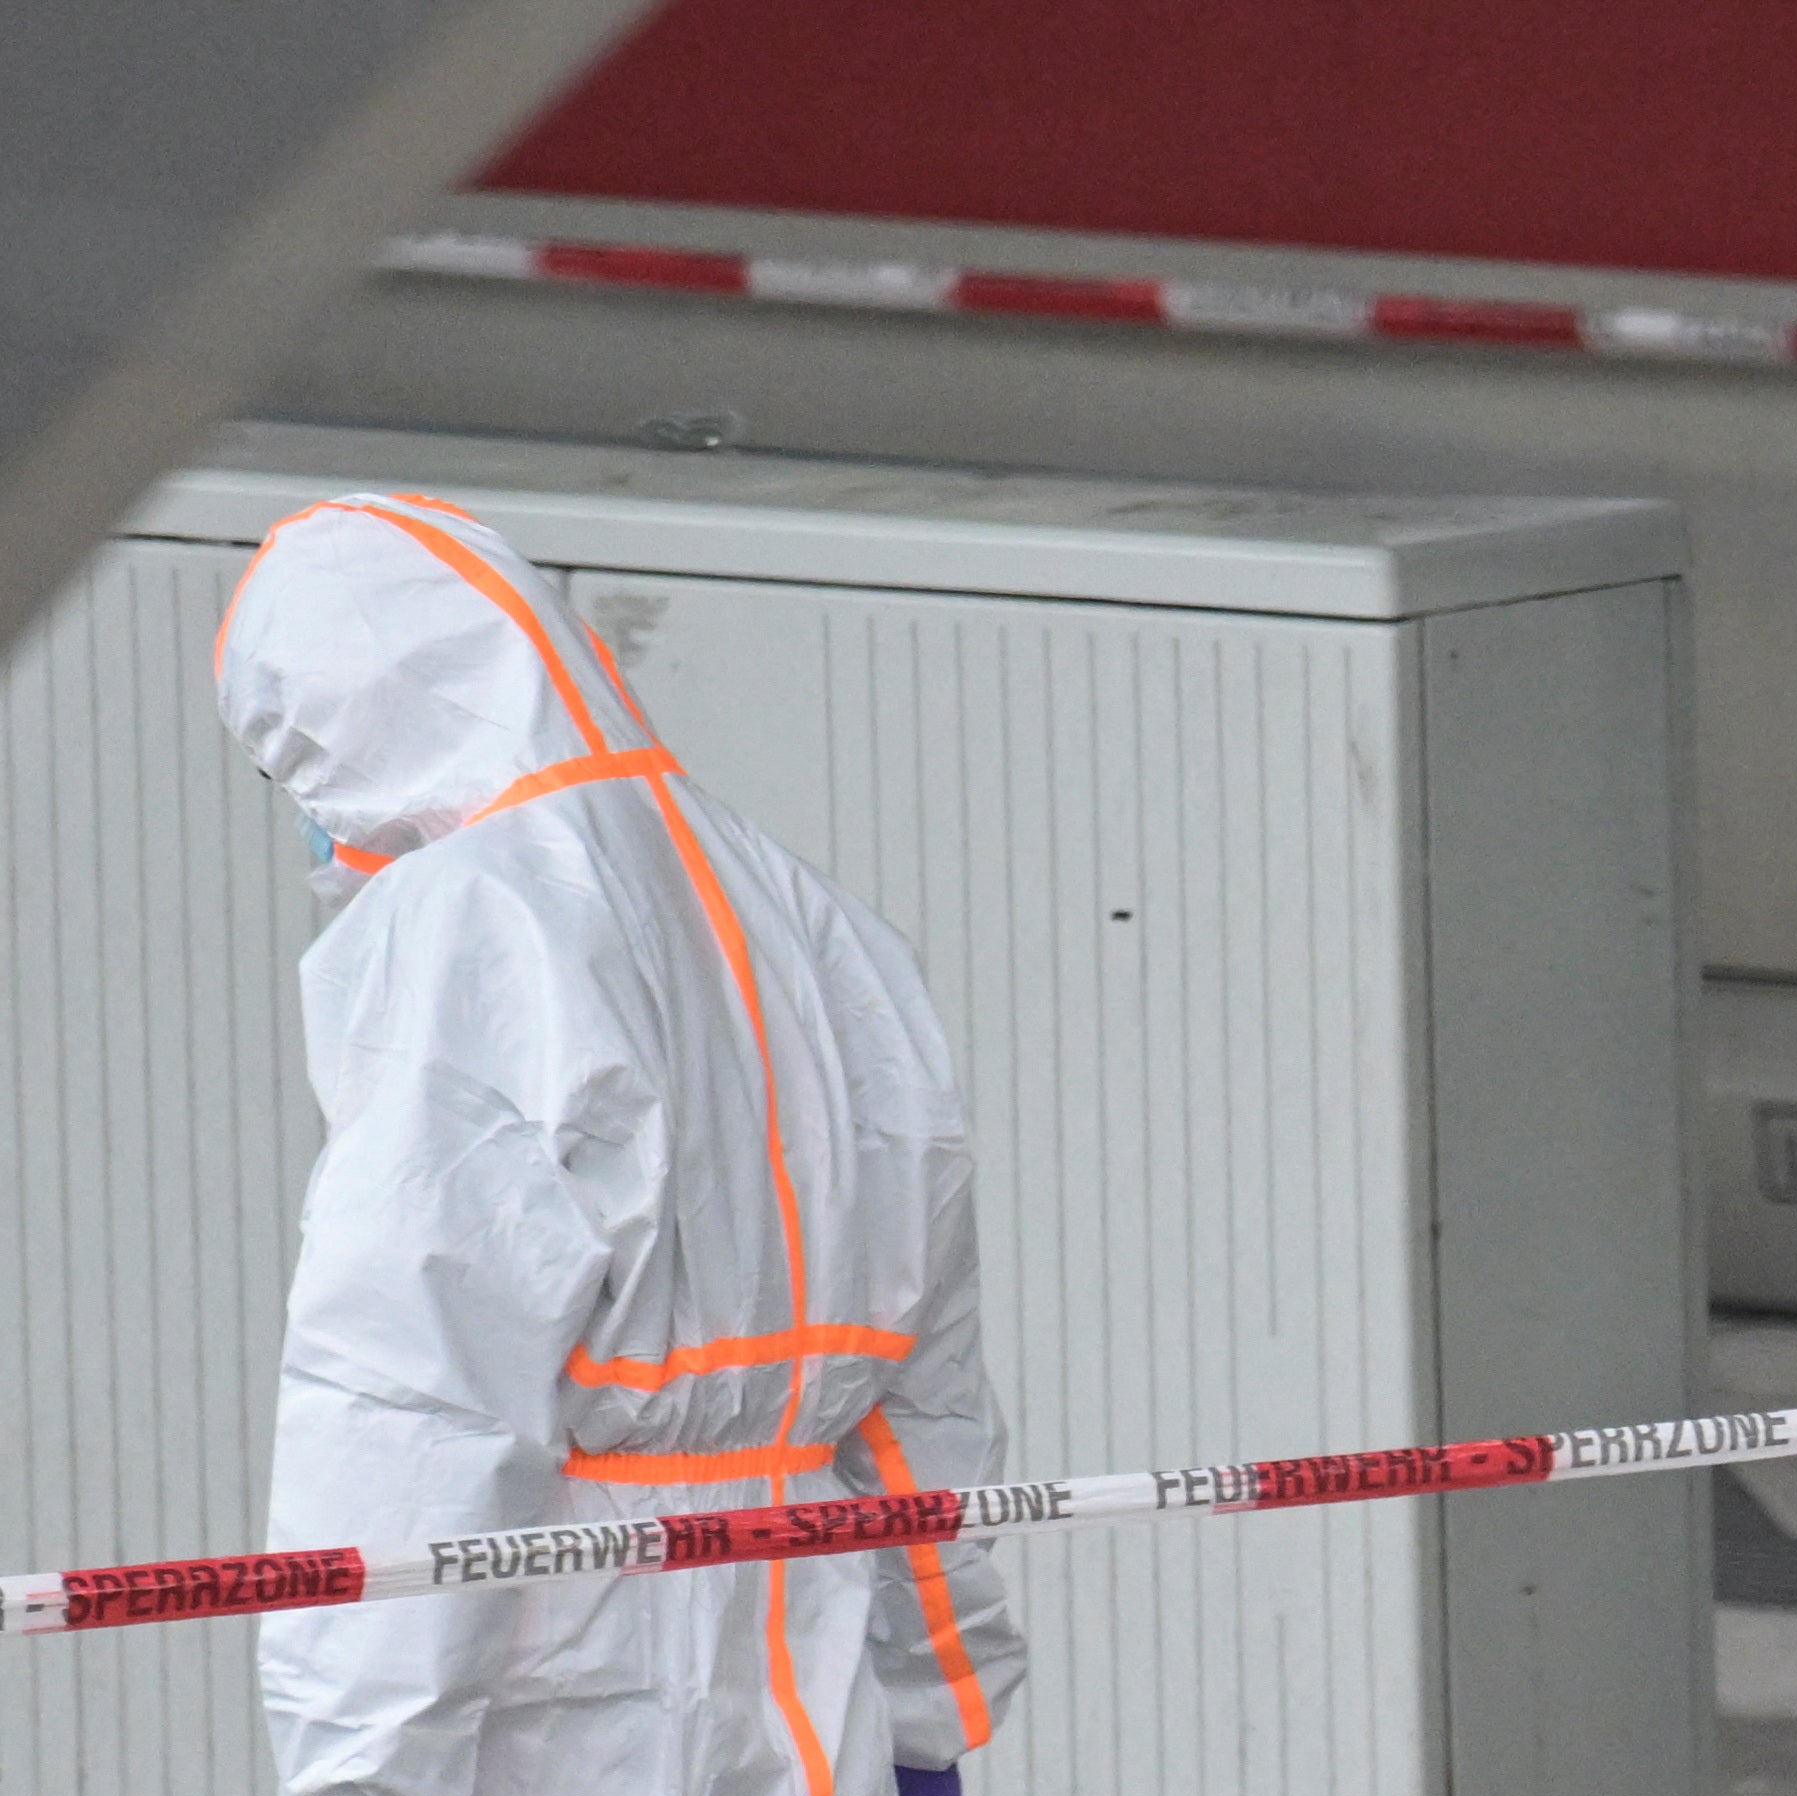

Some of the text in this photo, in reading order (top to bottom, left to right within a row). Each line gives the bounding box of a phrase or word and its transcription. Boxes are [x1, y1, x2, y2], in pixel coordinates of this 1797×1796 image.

[62, 1550, 350, 1626] SPERRZONE
[428, 1515, 731, 1586] FEUERWEHR
[1151, 1447, 1453, 1510] FEUERWEHR
[1504, 1411, 1791, 1475] SPERRZONE
